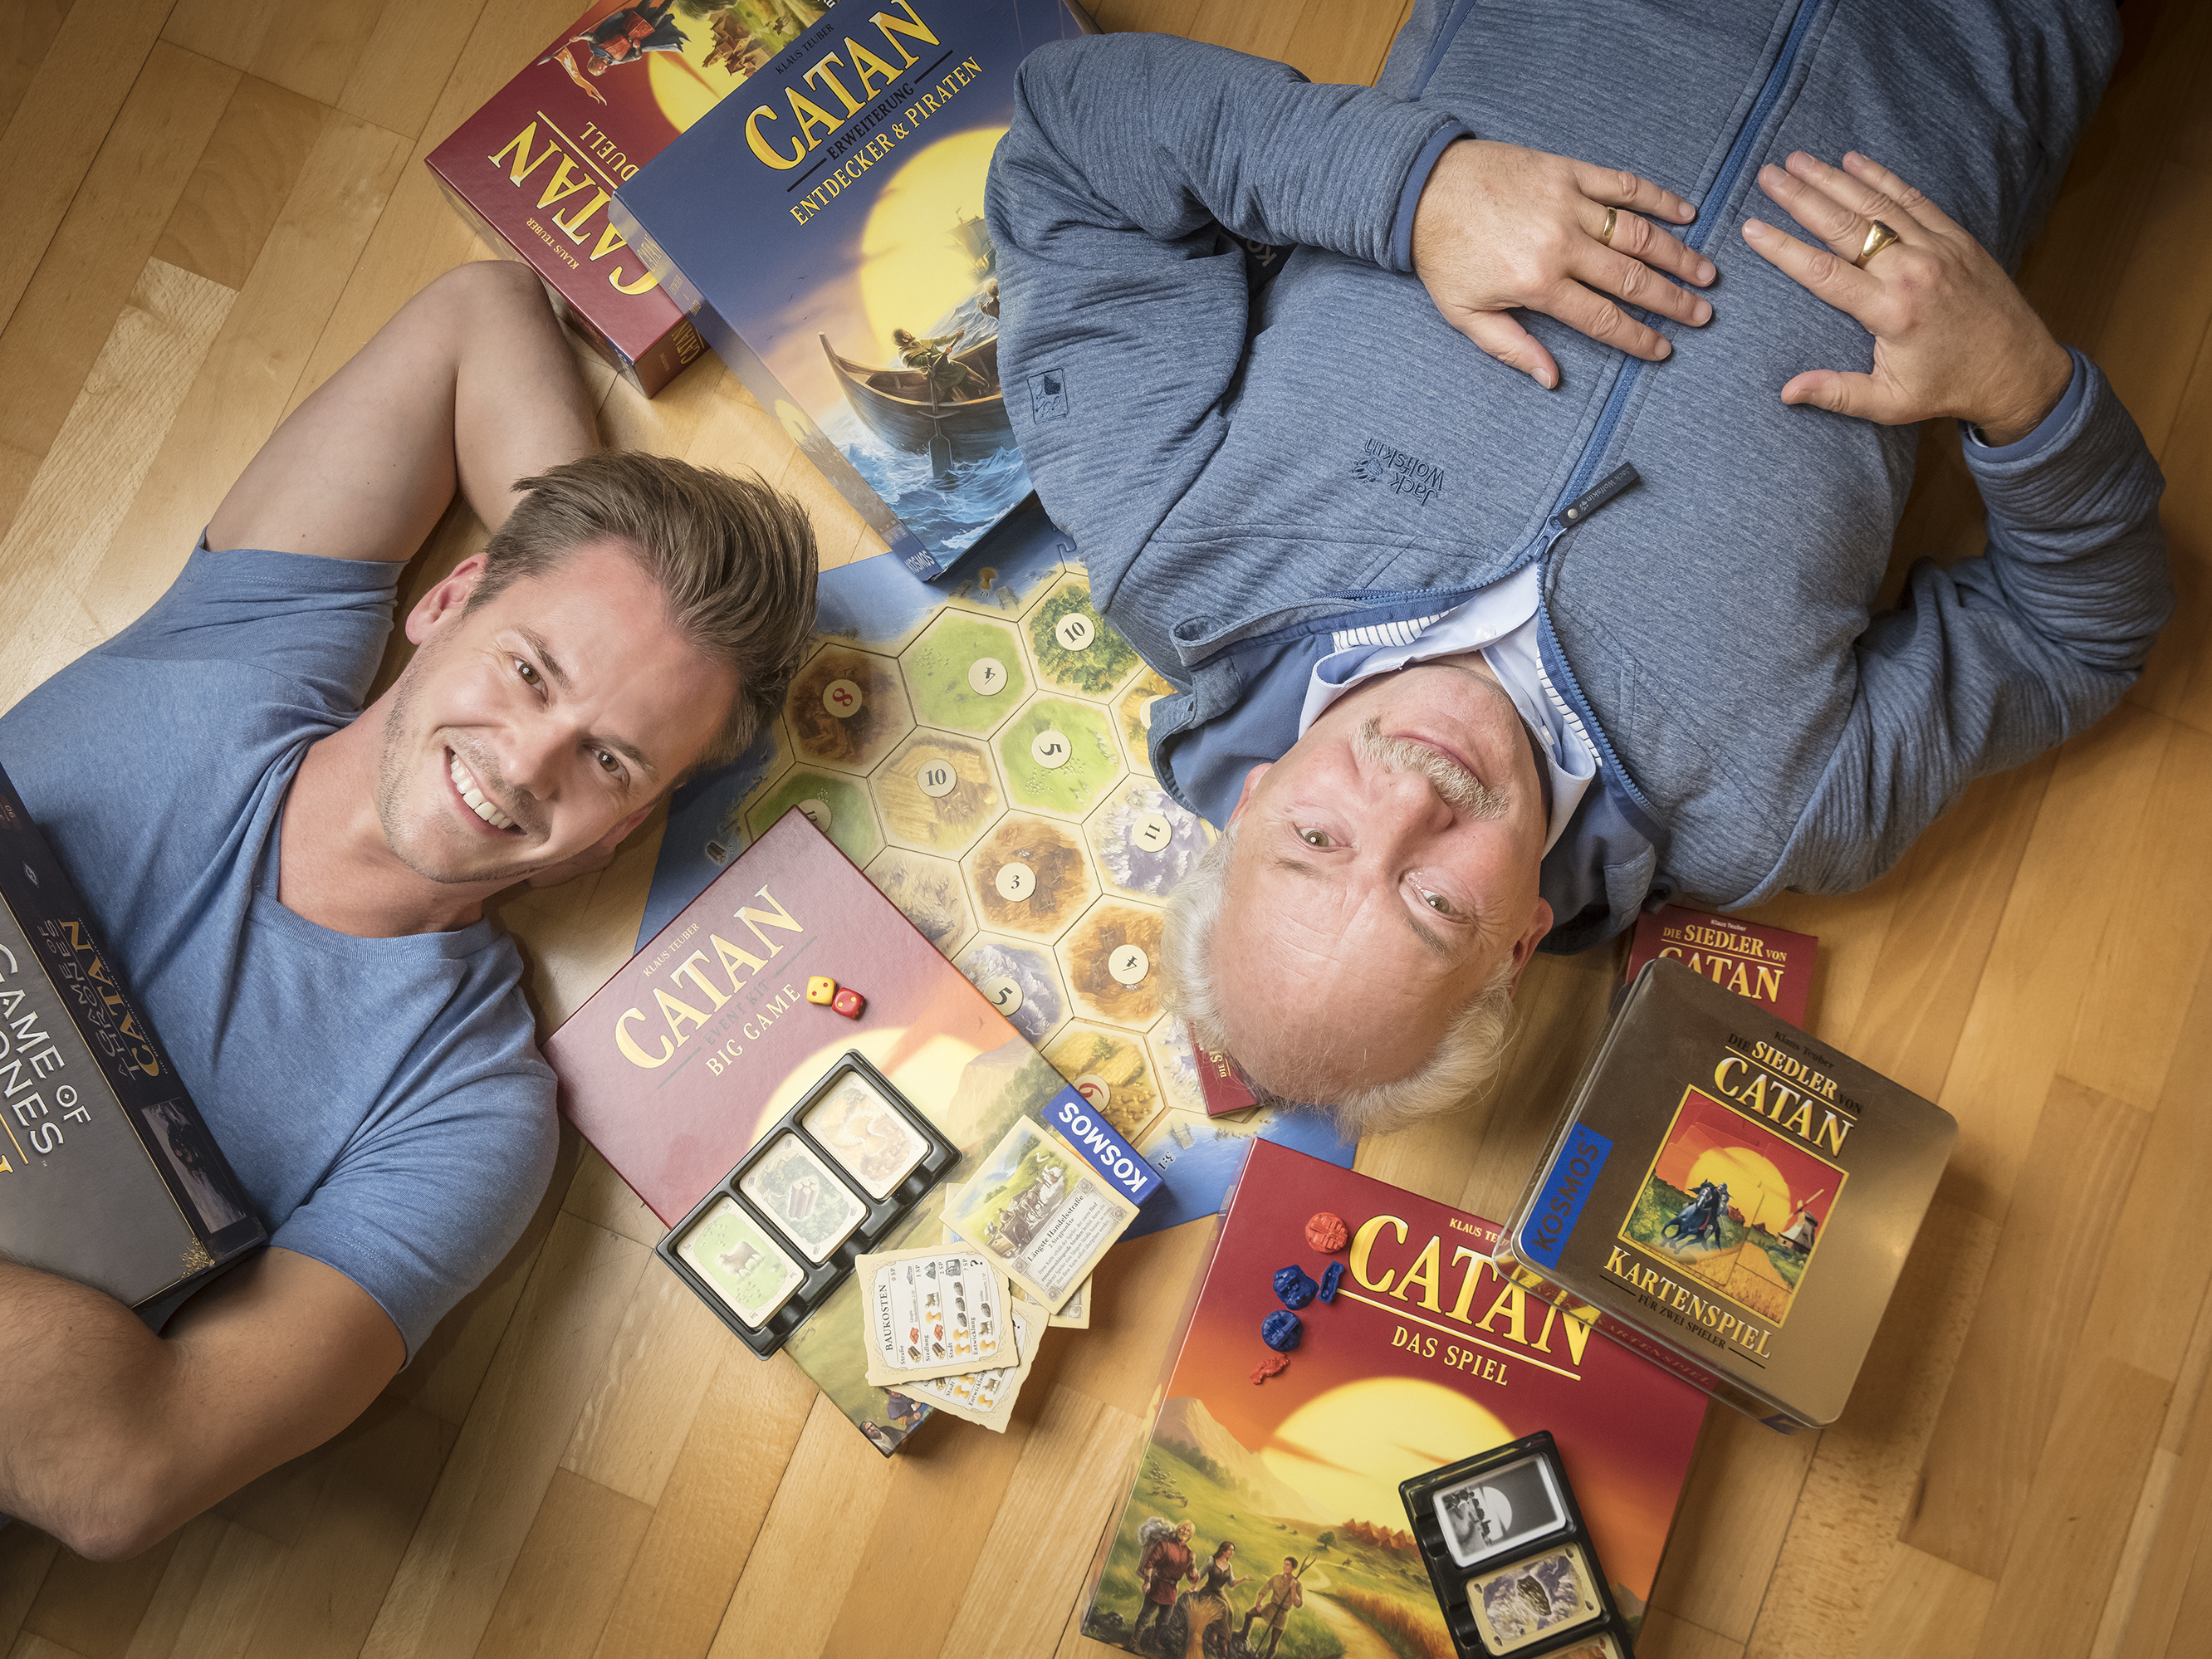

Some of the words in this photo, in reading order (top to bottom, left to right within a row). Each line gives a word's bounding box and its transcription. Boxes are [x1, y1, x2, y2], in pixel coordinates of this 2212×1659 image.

[776, 50, 802, 75] KLAUS
[801, 23, 834, 53] TEUBER
[745, 0, 941, 170] CATAN
[826, 83, 915, 160] ERWEITERUNG
[579, 121, 640, 182] DUELL
[790, 132, 896, 226] ENTDECKER
[891, 122, 910, 139] &
[904, 56, 983, 128] PIRATEN
[487, 120, 659, 295] CATAN
[526, 217, 554, 245] TEUBER
[553, 245, 580, 270] KLAUS
[672, 321, 700, 365] CATAN
[1365, 438, 1444, 491] Wolfskin
[1614, 467, 1630, 482] Jack
[1388, 473, 1438, 506] Jack
[1586, 479, 1616, 502] Wolfskin
[904, 550, 935, 574] KOSMOS
[1064, 621, 1086, 644] 10
[984, 668, 996, 685] 4
[832, 688, 854, 707] 8
[1039, 743, 1063, 756] 5
[925, 768, 947, 786] 10
[1144, 823, 1161, 840] 11
[1011, 874, 1020, 889] 3
[37, 925, 57, 954] OF
[1662, 927, 1681, 938] DIE
[1684, 924, 1764, 958] SIEDLER
[1764, 949, 1788, 962] VON
[1726, 922, 1746, 931] Teuber
[643, 951, 670, 977] KLAUS
[668, 922, 700, 952] TEUBER
[1123, 956, 1138, 971] 4
[614, 883, 805, 1069] CATAN
[44, 919, 140, 1081] THRONES
[58, 919, 159, 1077] CATAN
[59, 962, 116, 1057] GAME
[703, 1003, 746, 1046] EVENT
[745, 978, 770, 1006] KIT
[991, 986, 1014, 1005] 5
[705, 1039, 744, 1077] BIG
[743, 983, 801, 1040] GAME
[1774, 1031, 1800, 1050] Klaus
[1803, 1046, 1834, 1069] Teuber
[1218, 1063, 1227, 1078] DIE
[1728, 1033, 1751, 1052] DIE
[1751, 1040, 1838, 1100] SIEDLER
[1838, 1094, 1863, 1114] VON
[56, 1084, 92, 1123] OF
[1715, 1056, 1855, 1157] CATAN
[1059, 1102, 1148, 1193] KOSMOS
[1157, 1151, 1174, 1170] 3:1
[1532, 1141, 1599, 1252] KOSMOS
[1027, 1236, 1051, 1263] Längste
[1046, 1195, 1084, 1236] Handelsstraße
[1051, 1217, 1075, 1244] Siegpunkte
[1449, 1218, 1482, 1237] KLAUS
[890, 1267, 895, 1275] SP
[938, 1261, 943, 1270] SP
[962, 1258, 968, 1266] SP
[1349, 1214, 1601, 1367] CATAN
[1603, 1245, 1773, 1359] KARTENSPIEL
[878, 1285, 894, 1351] BAUKOSTEN
[969, 1316, 979, 1354] Entwicklung
[1637, 1293, 1658, 1312] FÜR
[1659, 1306, 1686, 1328] ZWEI
[1686, 1319, 1727, 1350] SPIELER
[898, 1345, 906, 1364] Straße
[922, 1334, 932, 1361] Siedlung
[1391, 1325, 1438, 1358] DAS
[1443, 1345, 1508, 1386] SPIEL
[945, 1380, 955, 1397] Stadt
